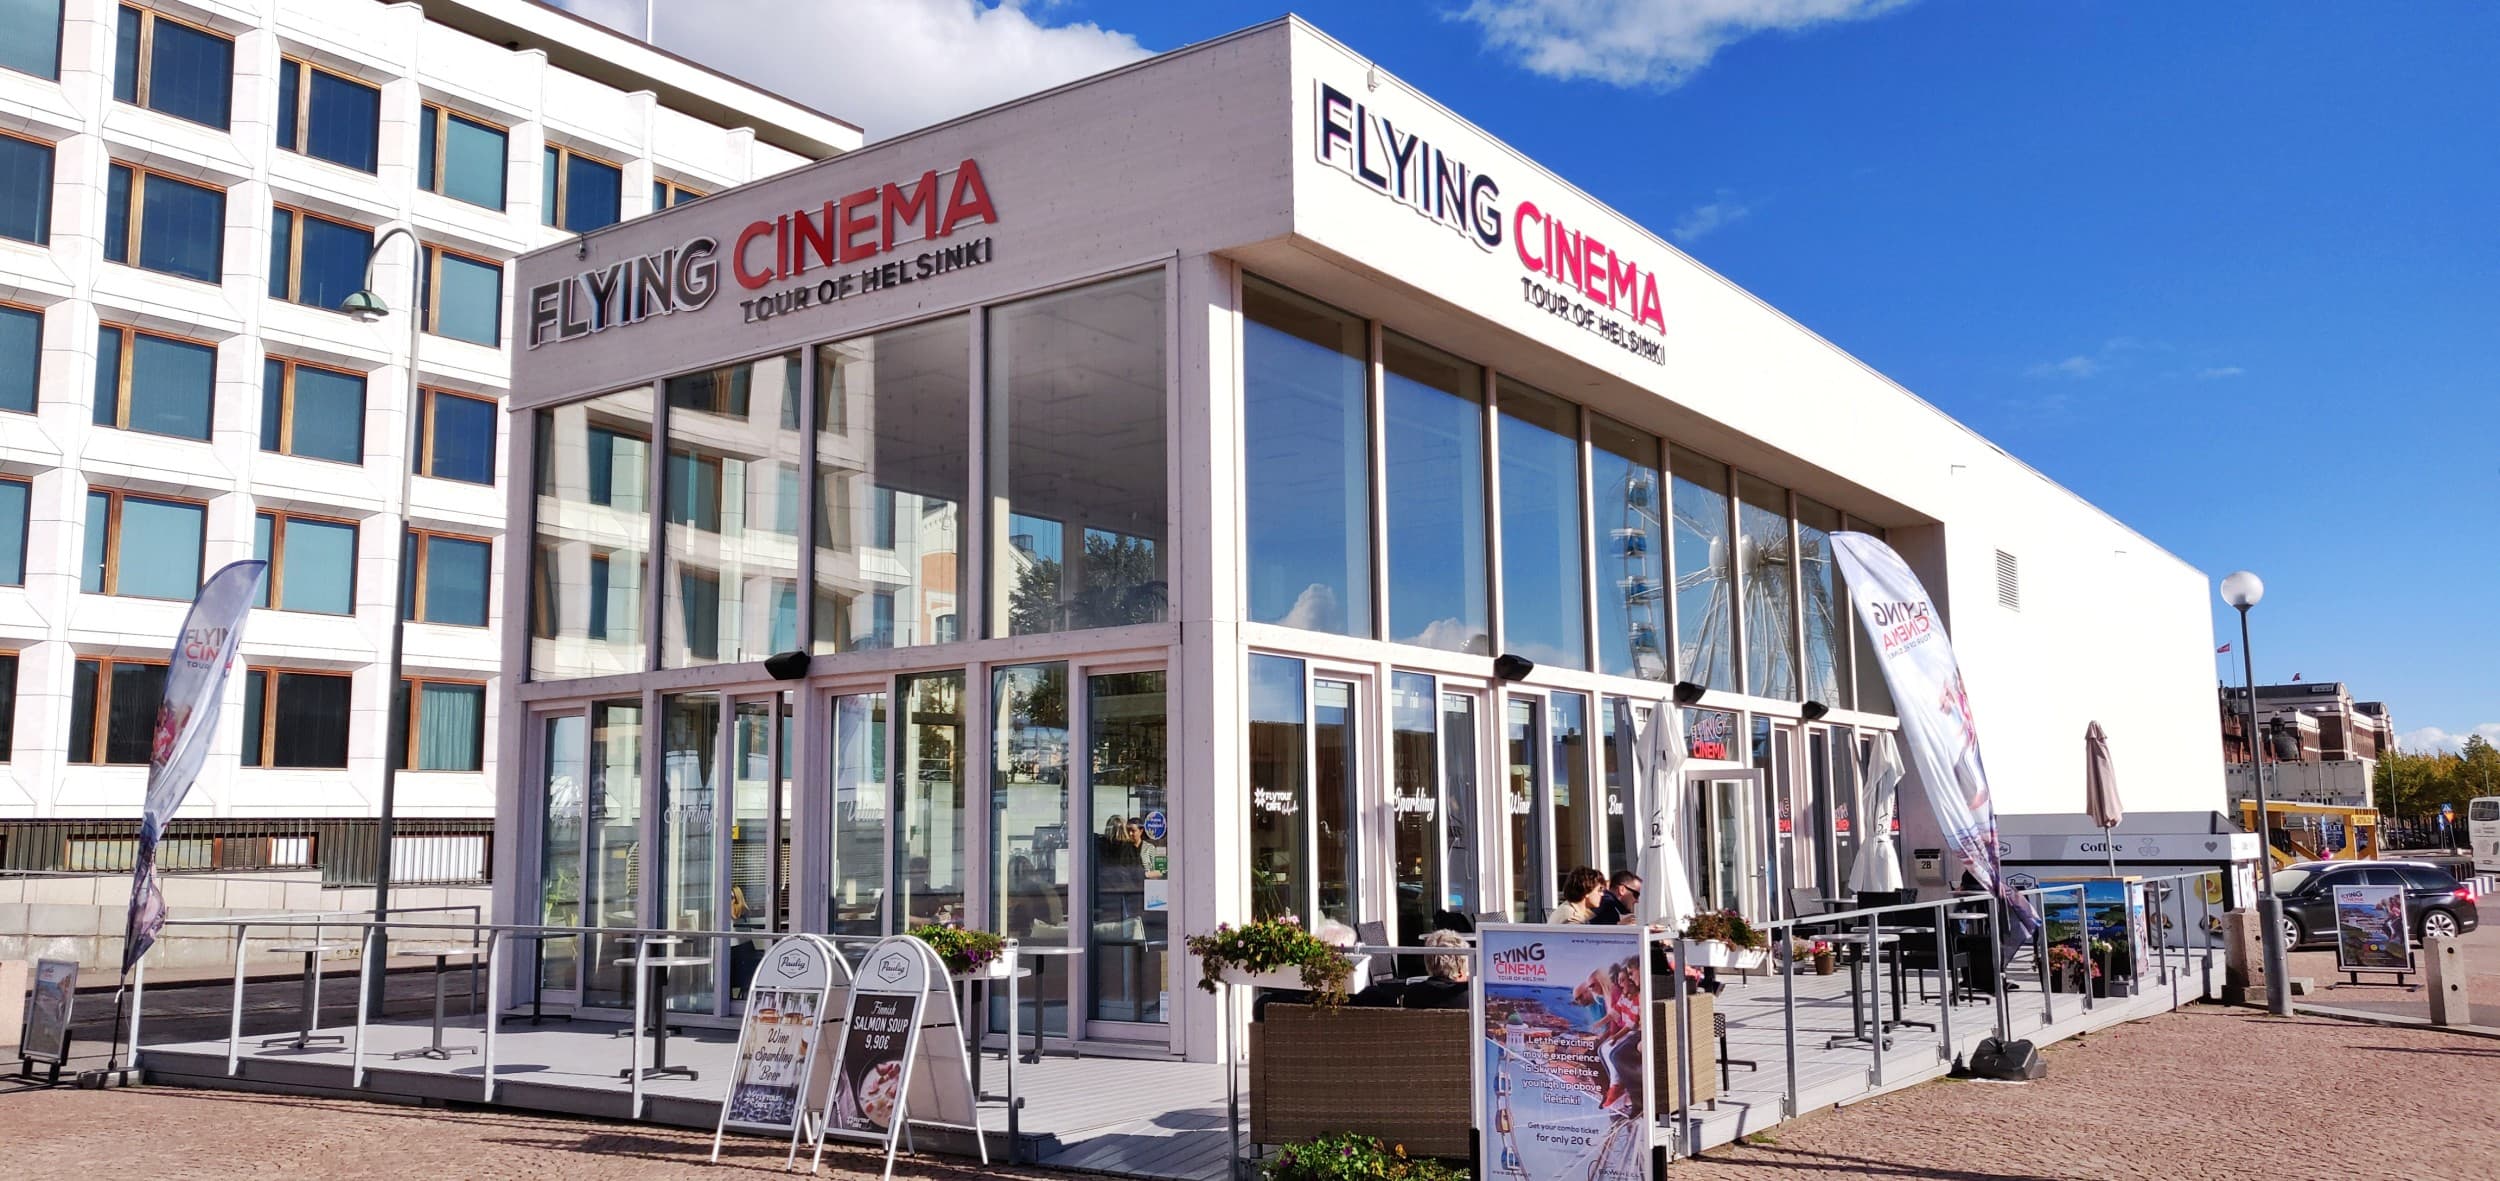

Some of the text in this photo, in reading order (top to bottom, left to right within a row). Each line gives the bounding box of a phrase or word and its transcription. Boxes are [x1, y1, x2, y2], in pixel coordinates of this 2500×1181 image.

[1315, 79, 1666, 336] FLYING CINEMA
[528, 158, 997, 350] FLYING CINEMA
[740, 237, 992, 324] TOUR OF HELSINKI
[1521, 277, 1666, 366] TOUR OF HELSINKI
[1693, 741, 1727, 759] CINEMA
[1394, 786, 1435, 822] Sparkling
[1509, 791, 1531, 814] Wine
[1921, 861, 1932, 869] 2B
[1493, 943, 1545, 964] FLYING
[780, 956, 805, 970] Paulig
[881, 960, 905, 975] Paulig
[1495, 964, 1547, 976] CINEMA
[872, 1001, 897, 1014] Finnish
[854, 1016, 909, 1033] SALMON SOUP
[768, 1029, 790, 1044] Wine
[865, 1034, 890, 1050] 9,90€
[1528, 1036, 1594, 1050] Let the exciting
[755, 1047, 793, 1069] Sparkling
[1523, 1051, 1600, 1062] movie experience
[759, 1066, 781, 1081] Beer
[1579, 1067, 1599, 1077] take
[1523, 1080, 1602, 1092] you high up above
[1544, 1094, 1581, 1105] Helsinki!
[1540, 1124, 1556, 1132] your
[1557, 1125, 1579, 1133] combo
[1581, 1127, 1599, 1135] ticket
[1536, 1134, 1592, 1146] for only 20 €
